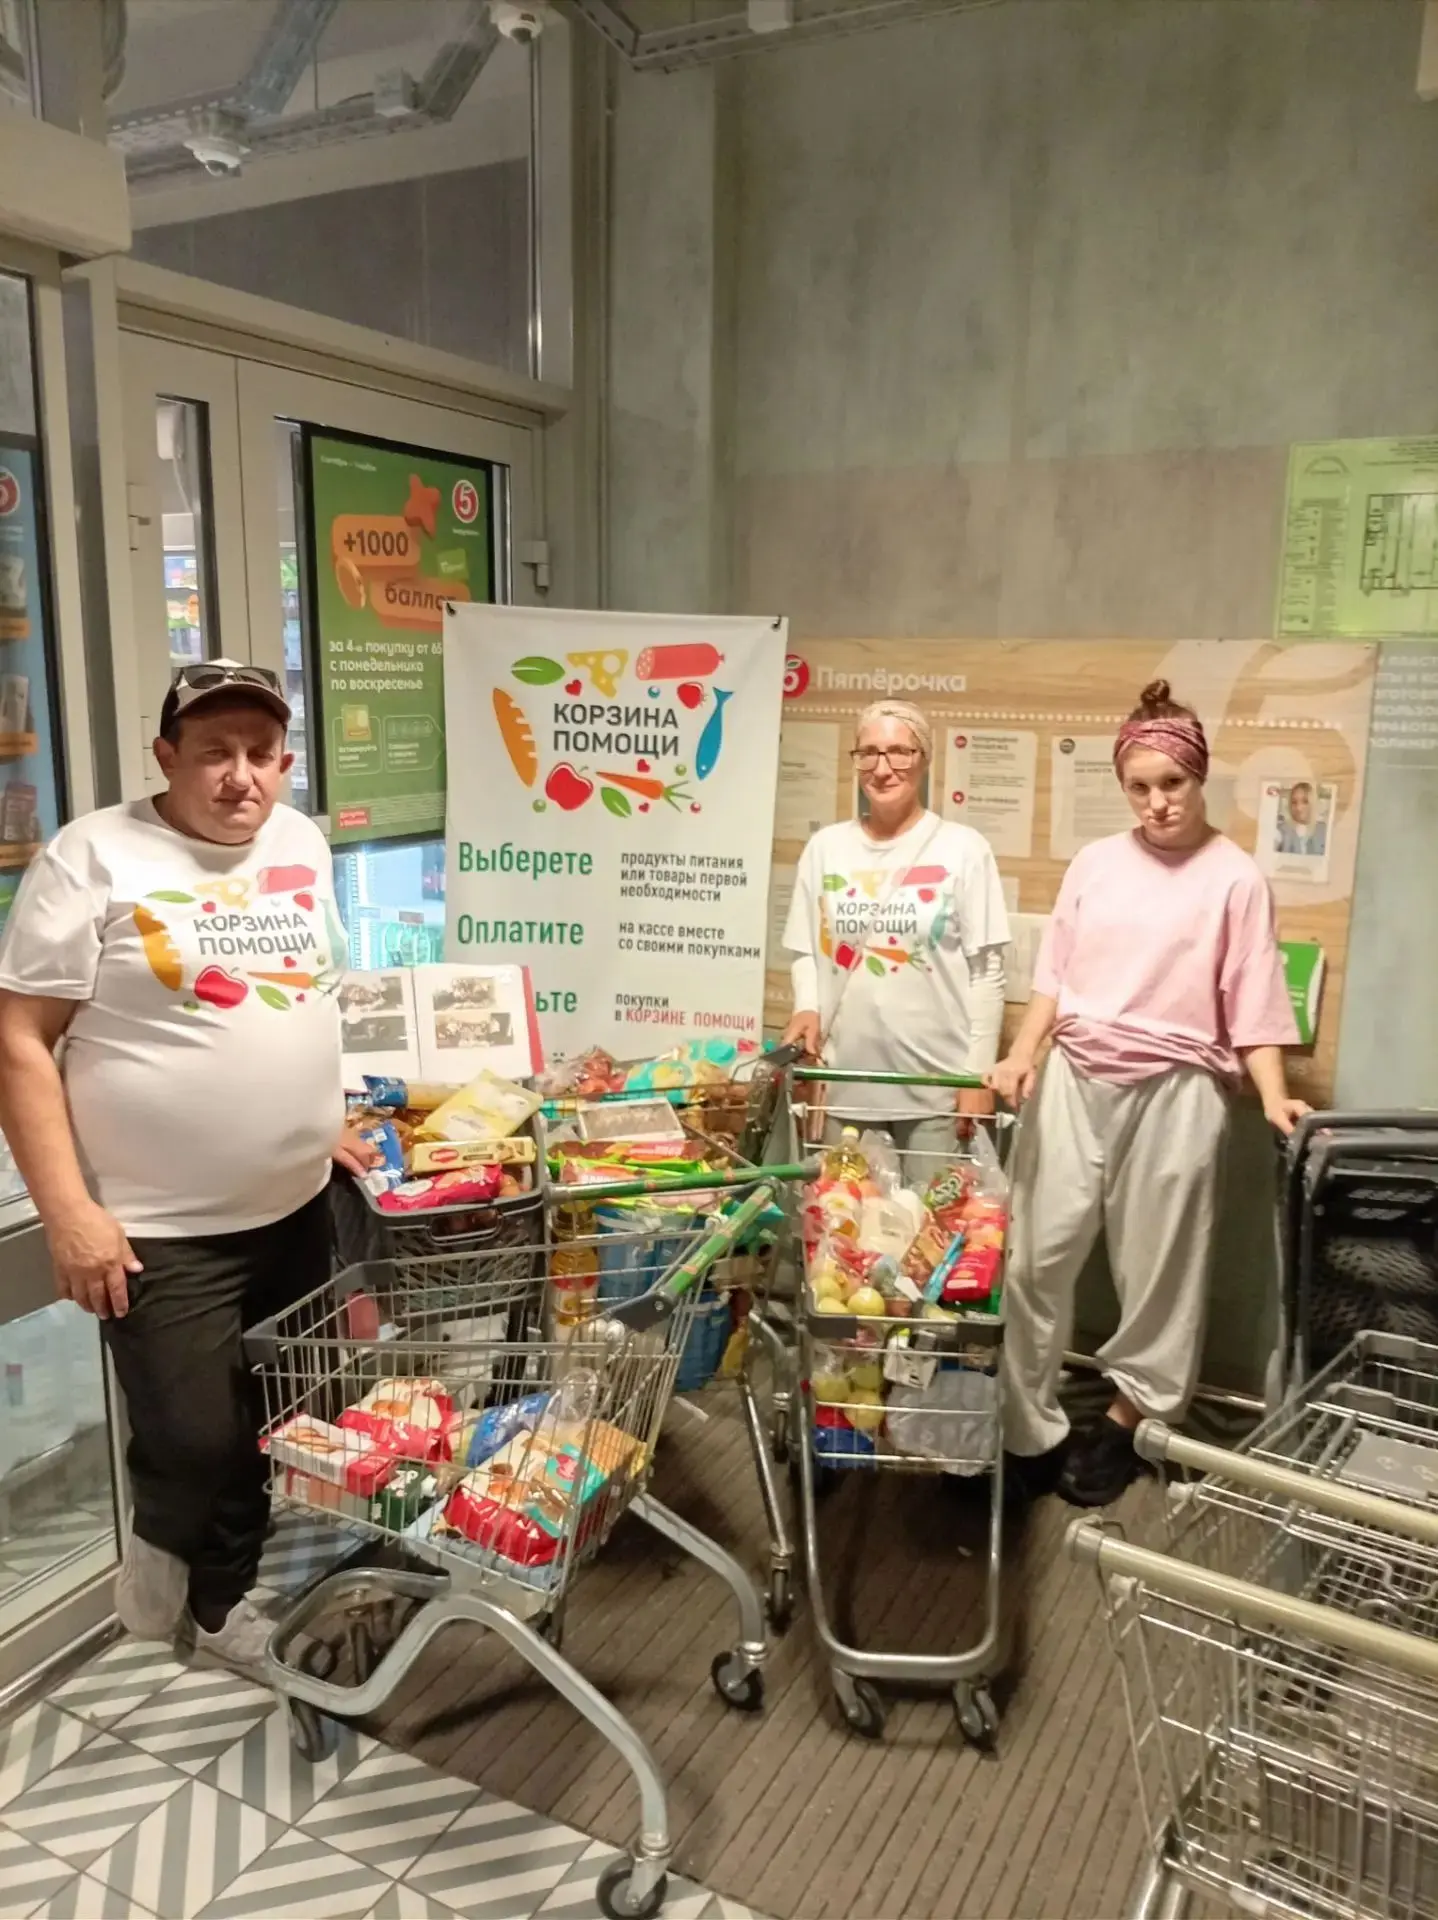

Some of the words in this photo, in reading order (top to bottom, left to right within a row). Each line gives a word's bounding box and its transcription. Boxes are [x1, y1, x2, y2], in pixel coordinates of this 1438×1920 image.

[344, 528, 409, 557] +1000
[384, 581, 457, 612] балло
[328, 640, 344, 652] за
[365, 641, 415, 658] покупку
[416, 643, 429, 655] от
[329, 660, 337, 672] с
[340, 656, 424, 672] понедельника
[331, 679, 347, 691] по
[349, 679, 424, 694] воскресенье
[816, 666, 967, 697] Пятёрочка
[553, 703, 679, 730] КОРЗИНА
[553, 730, 679, 761] ПОМОЩИ
[459, 842, 593, 880] Выберете
[621, 853, 686, 868] продукты
[690, 855, 743, 869] питания
[621, 869, 645, 881] или
[650, 869, 696, 885] товары
[700, 872, 747, 890] первой
[620, 884, 721, 901] необходимости
[835, 901, 917, 916] КОРЗИНА
[193, 912, 308, 933] КОРЗИНА
[457, 914, 584, 945] Оплатите
[619, 922, 634, 933] на
[638, 923, 674, 936] кассе
[678, 926, 725, 940] вместе
[835, 919, 917, 936] ПОМОЩИ
[198, 932, 318, 956] ПОМОЩИ
[618, 938, 633, 950] со
[636, 939, 684, 954] своими
[687, 942, 760, 959] покупками
[616, 993, 669, 1009] покупки
[615, 1009, 622, 1021] в
[626, 1008, 686, 1026] КОРЗИНЕ
[693, 1011, 756, 1031] ПОМОЩИ
